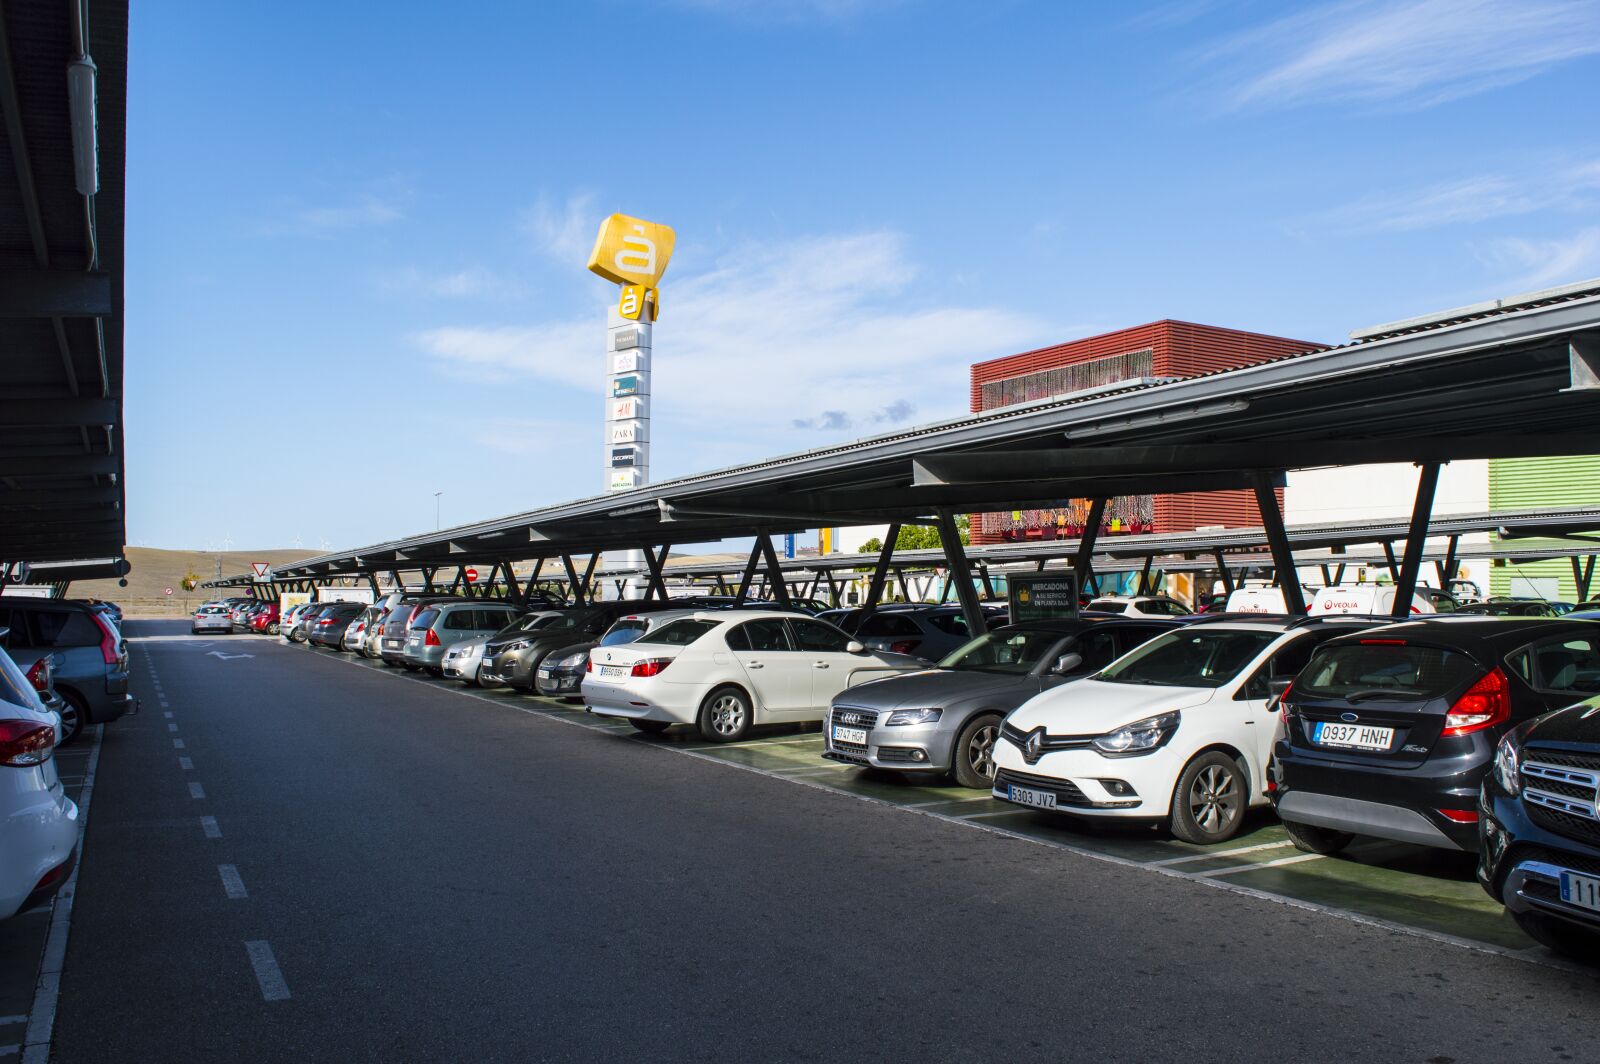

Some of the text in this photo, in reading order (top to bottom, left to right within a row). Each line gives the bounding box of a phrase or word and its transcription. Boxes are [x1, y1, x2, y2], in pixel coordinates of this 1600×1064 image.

[614, 430, 633, 439] ZARA
[1032, 583, 1069, 591] MERCADONA
[836, 728, 865, 742] 9747 HGF
[1322, 726, 1356, 741] 0937
[1360, 729, 1389, 745] HNH
[1012, 788, 1054, 808] 5303 JVZ
[1576, 880, 1600, 905] 11
